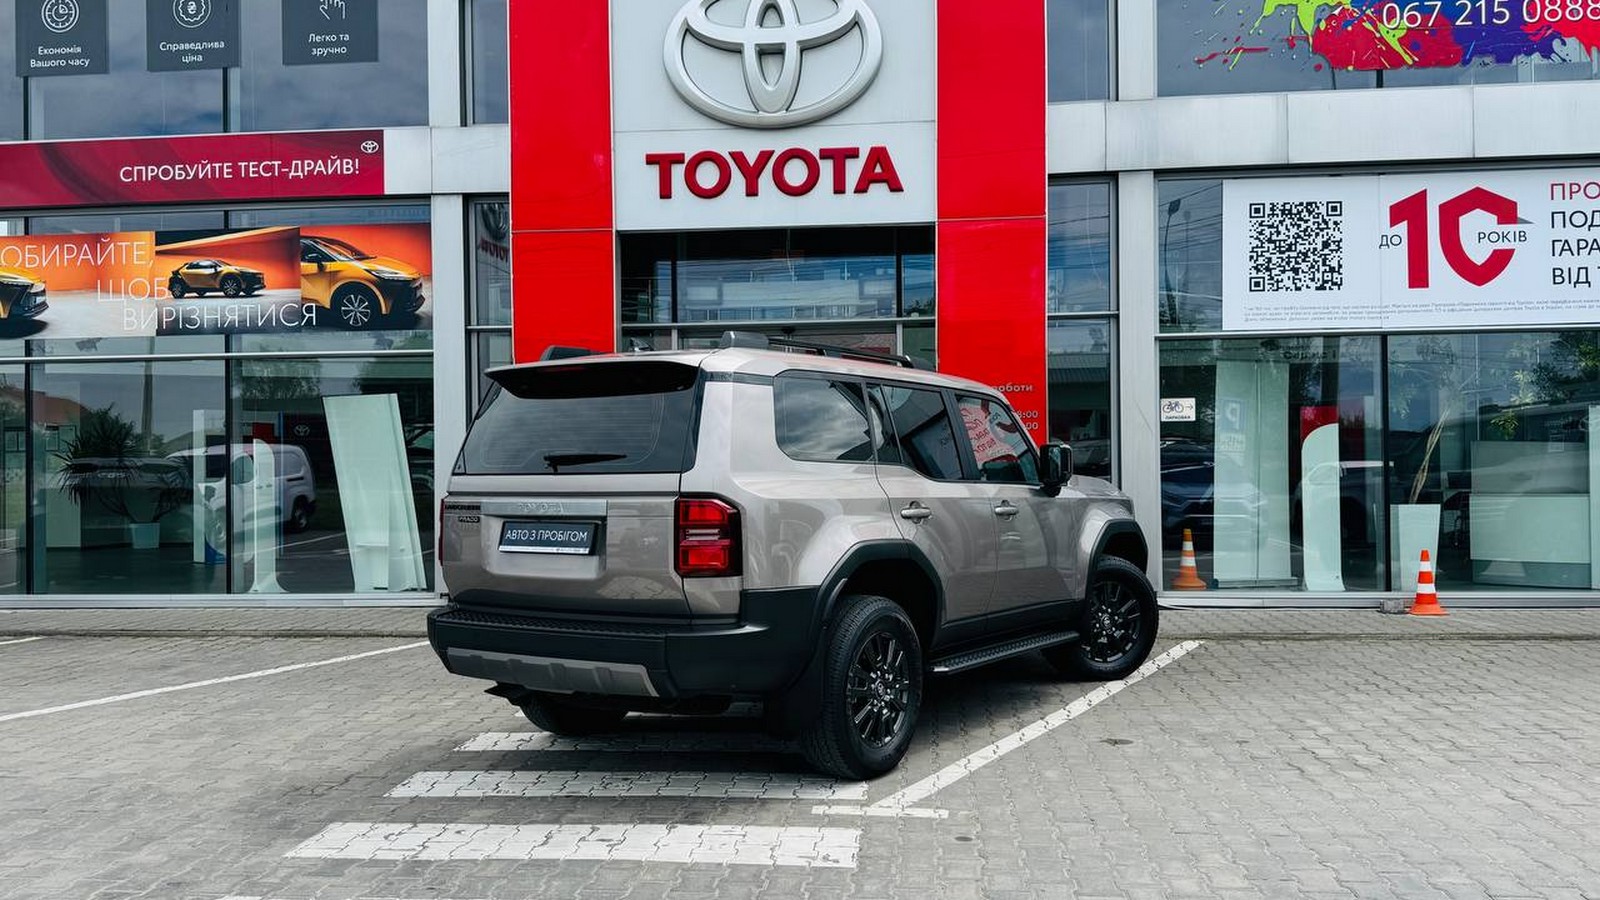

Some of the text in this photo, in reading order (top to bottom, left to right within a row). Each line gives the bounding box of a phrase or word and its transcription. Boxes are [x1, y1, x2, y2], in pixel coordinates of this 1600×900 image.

[1382, 2, 1440, 29] 067
[1455, 0, 1511, 27] 215
[308, 33, 350, 44] Легко та
[37, 44, 82, 56] Економія
[159, 39, 225, 53] Справедлива
[311, 46, 347, 57] зручно
[30, 58, 90, 68] Вашого часу
[181, 52, 203, 64] ціна
[119, 155, 361, 183] СПРОБУЙТЕ ТЕСТ-ДРАЙВ!
[645, 145, 904, 200] TOYOTA
[1379, 235, 1402, 249] ДО
[1477, 230, 1528, 244] РОКІВ
[1552, 266, 1591, 288] ВІД
[97, 278, 168, 308] ЩОБ
[123, 303, 317, 331] ВИРІЗНЯТИСЯ
[505, 530, 529, 540] АВТО
[538, 530, 588, 542] ПРОБІГОМ
